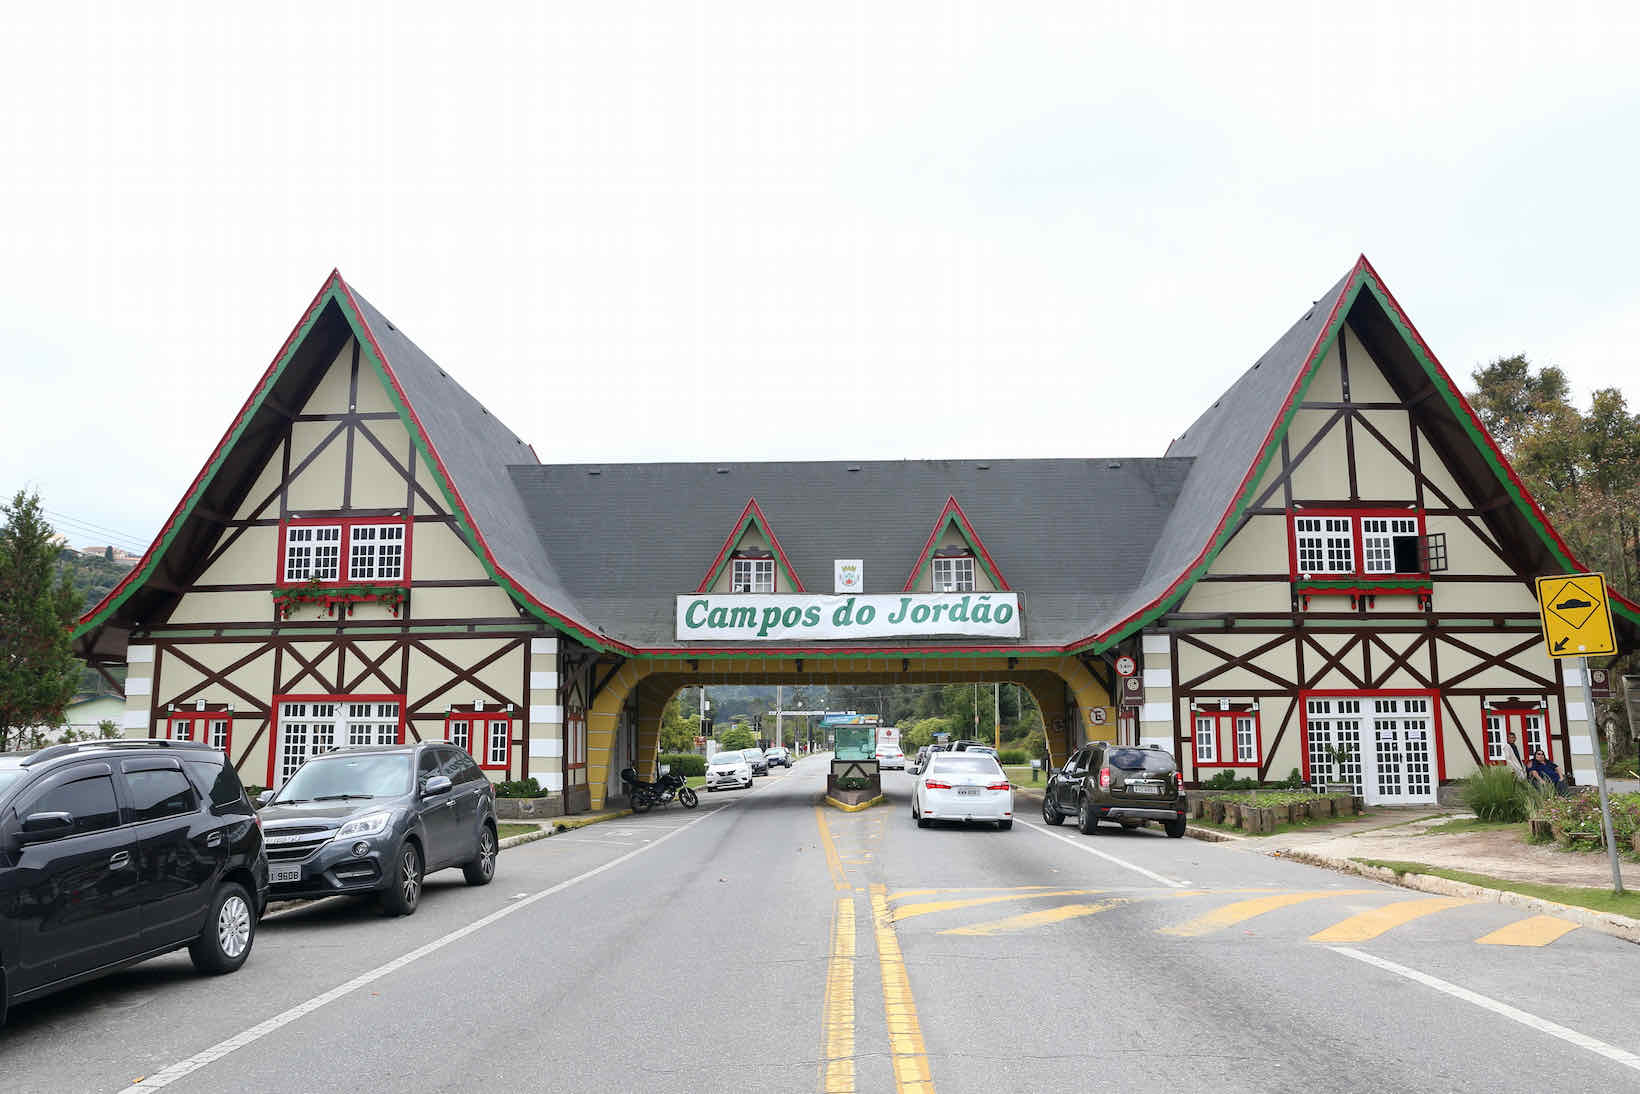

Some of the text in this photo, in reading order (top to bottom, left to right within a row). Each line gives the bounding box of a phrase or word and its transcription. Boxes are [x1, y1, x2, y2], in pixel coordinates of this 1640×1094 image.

[685, 596, 1013, 637] Campos do Jordão
